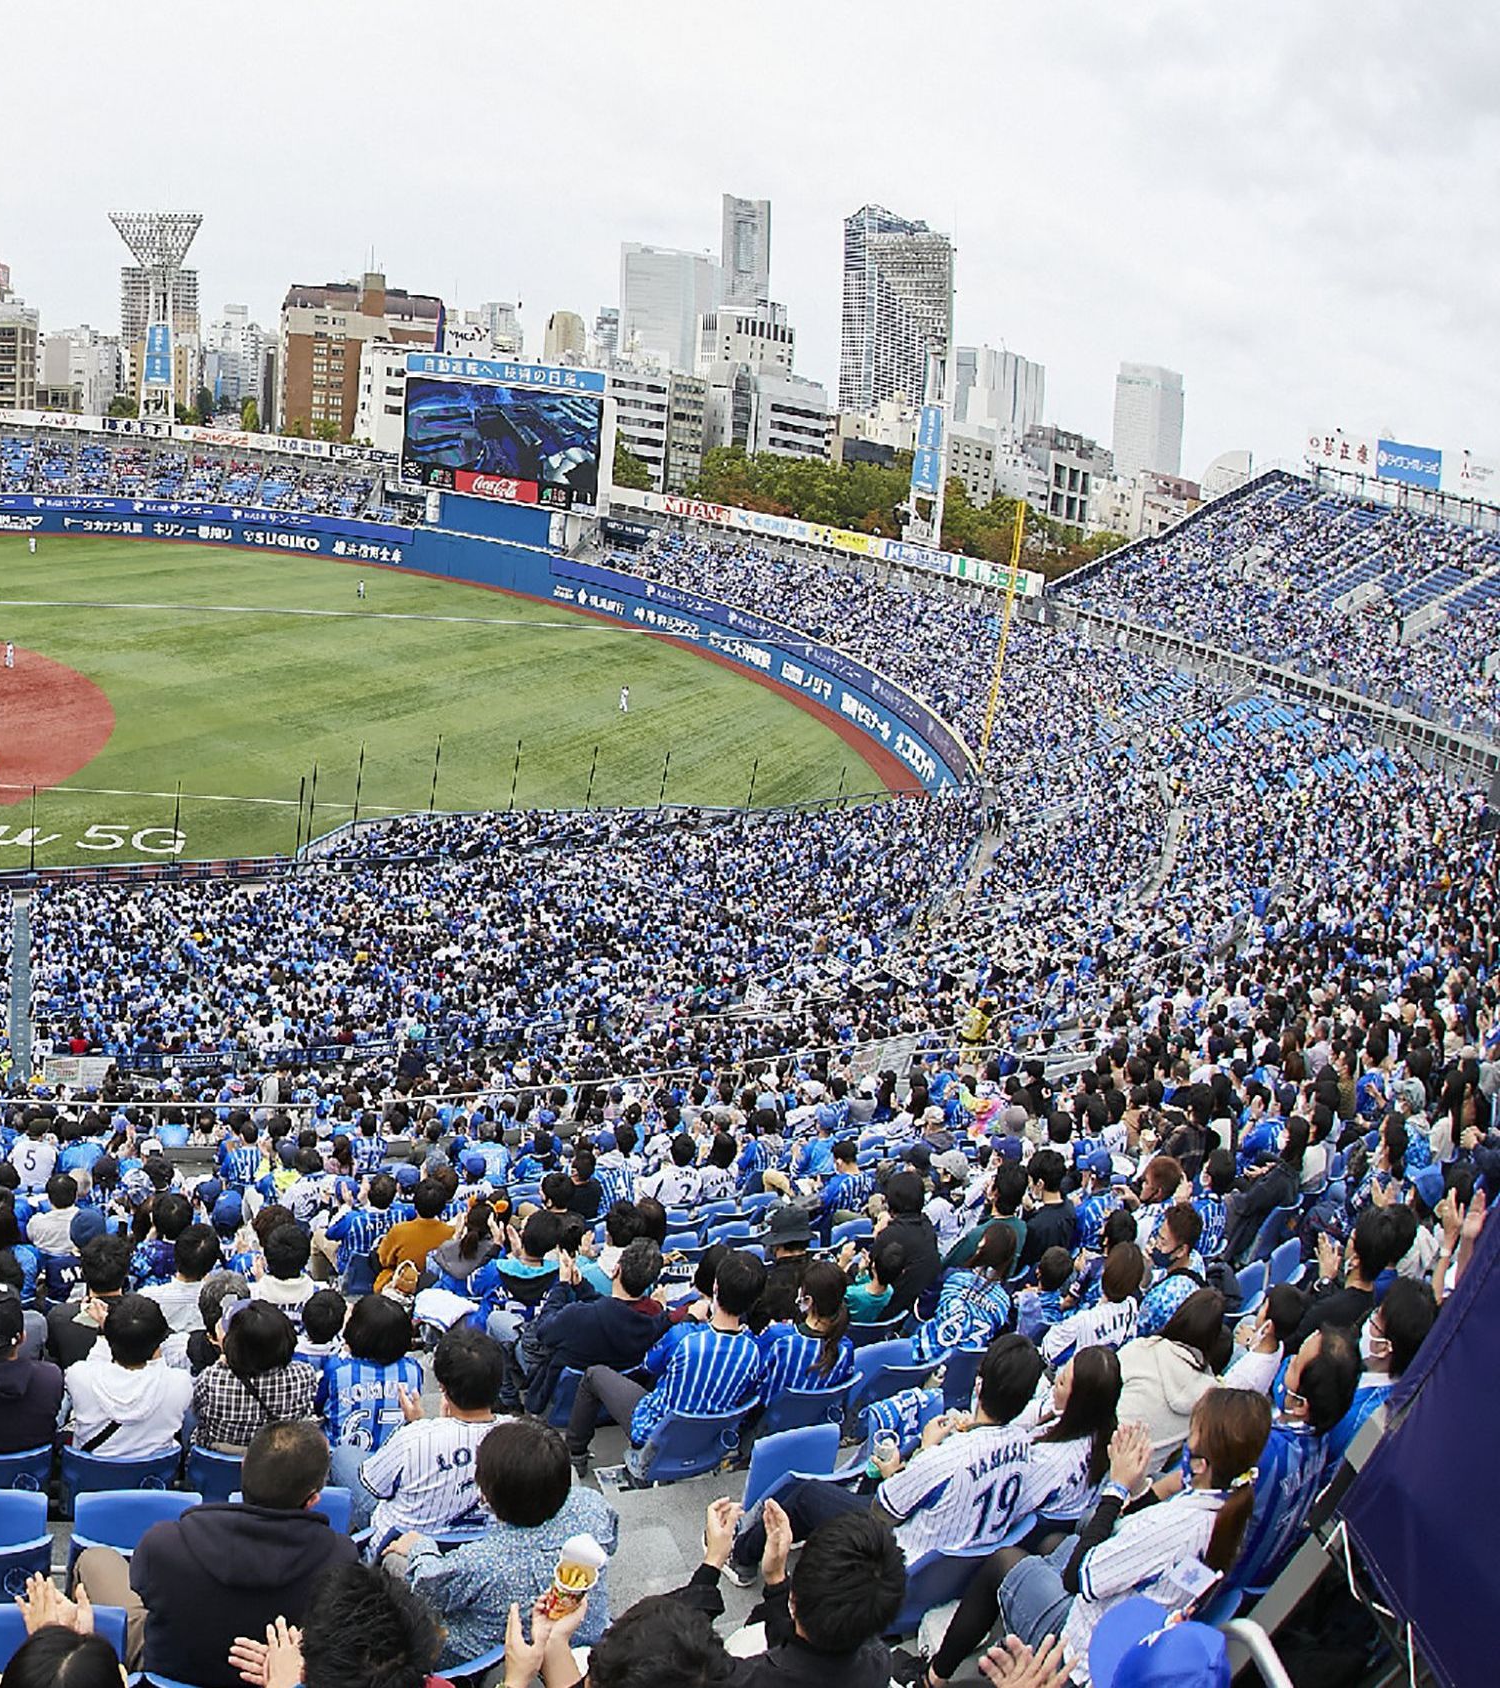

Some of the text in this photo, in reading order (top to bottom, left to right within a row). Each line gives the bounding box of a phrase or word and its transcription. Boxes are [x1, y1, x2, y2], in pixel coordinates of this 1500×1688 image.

[153, 523, 232, 539] キリン一番搾り
[254, 532, 320, 551] SUGIKO
[75, 824, 187, 855] 5G
[25, 1149, 36, 1171] 5
[972, 1472, 1022, 1540] 19
